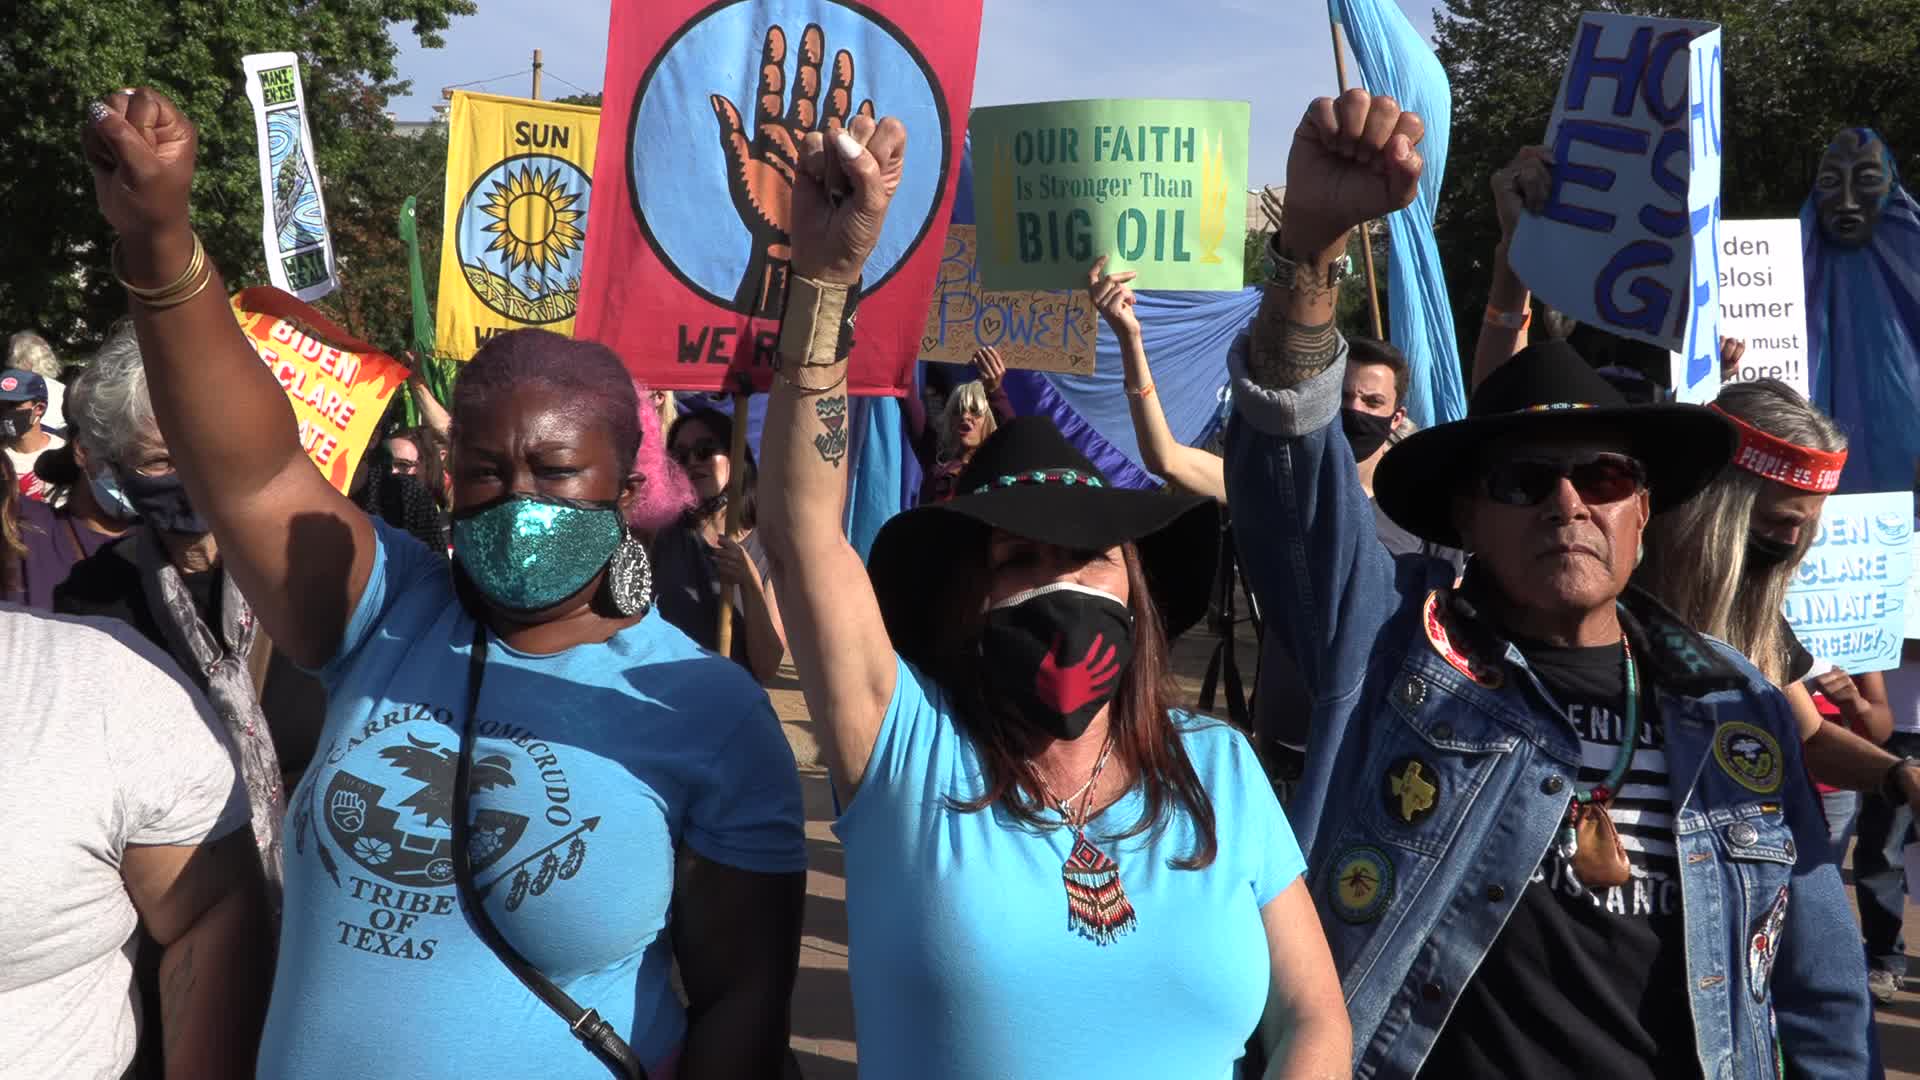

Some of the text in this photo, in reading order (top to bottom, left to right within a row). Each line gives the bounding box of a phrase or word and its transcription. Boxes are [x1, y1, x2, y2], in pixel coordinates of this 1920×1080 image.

[514, 120, 570, 149] SUN
[1014, 125, 1196, 167] OUR FAITH
[1015, 172, 1193, 204] Is Stronger Than
[1015, 208, 1095, 264] BIG
[1116, 207, 1192, 263] OIL
[1722, 235, 1770, 256] den
[1719, 266, 1773, 288] elosi
[939, 290, 1089, 350] POWER
[271, 320, 360, 388] BIDEN
[677, 325, 737, 364] WE
[1751, 333, 1800, 350] must
[1738, 446, 1792, 481] PEOPLE
[1794, 553, 1888, 586] CLARE
[1784, 591, 1888, 626] LIMATE
[1800, 628, 1884, 658] ERGENCY
[327, 703, 454, 765] CARRIZO
[477, 718, 573, 827] OMECRUDO
[349, 876, 457, 916] TRIBE
[368, 908, 420, 934] OF
[337, 920, 439, 961] TEXAS
